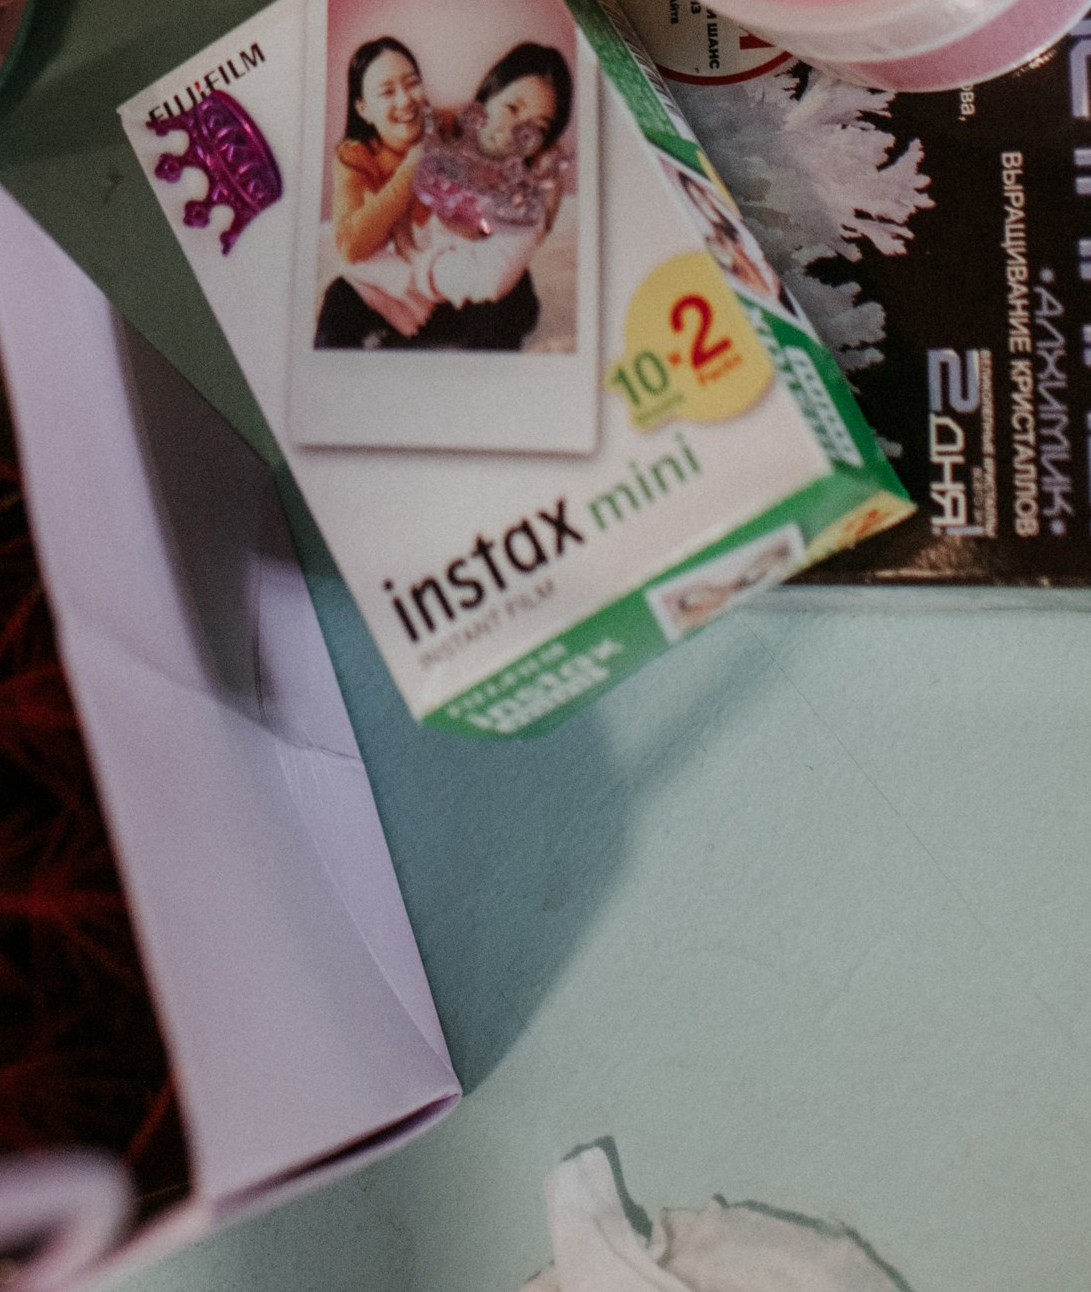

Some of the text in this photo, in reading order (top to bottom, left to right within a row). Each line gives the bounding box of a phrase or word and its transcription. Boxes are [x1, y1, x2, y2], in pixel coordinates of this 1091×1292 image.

[707, 23, 720, 70] ШАНС
[928, 348, 982, 413] 2
[1001, 151, 1041, 537] ВЫРАЩИВАНИЕ КРИСТАЛЛОВ
[1034, 287, 1074, 516] АЛХИМИК
[382, 432, 701, 644] instax mini
